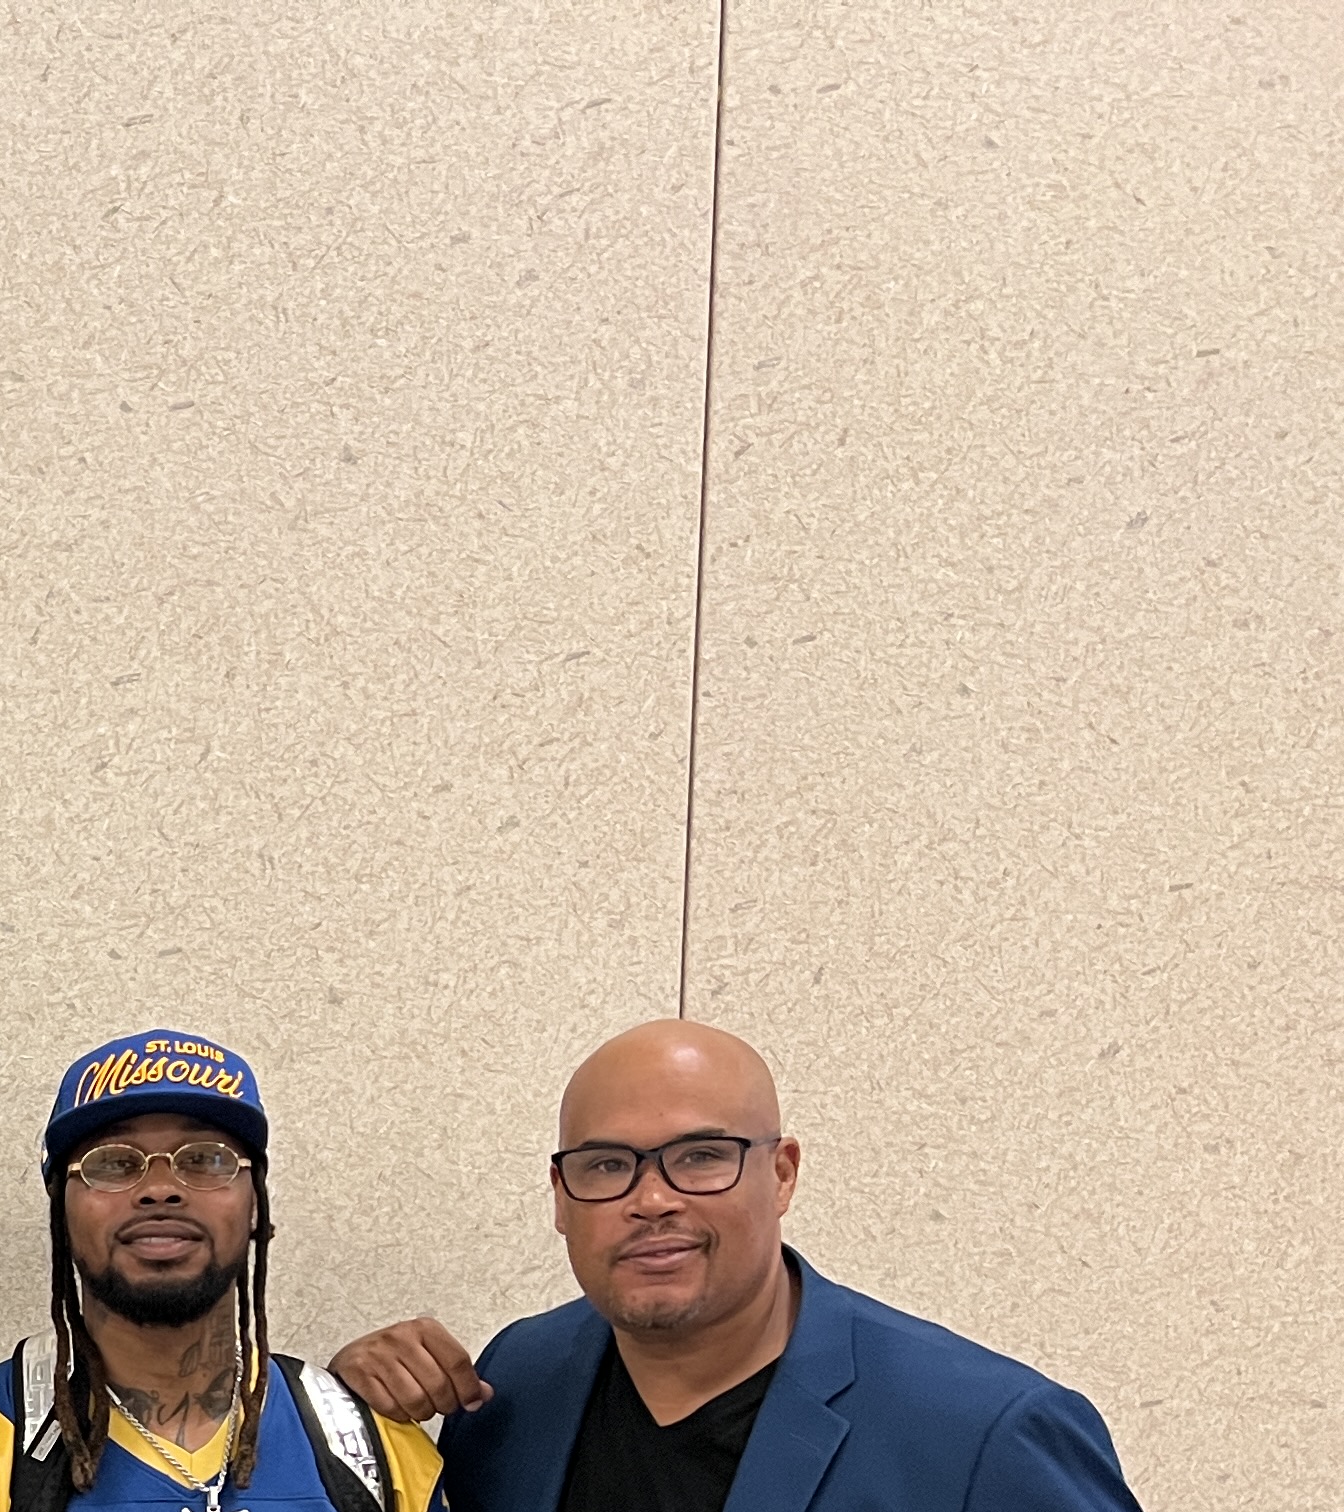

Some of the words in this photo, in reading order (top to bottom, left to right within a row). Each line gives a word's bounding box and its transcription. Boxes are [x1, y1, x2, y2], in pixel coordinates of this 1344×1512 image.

[145, 1040, 171, 1054] ST.
[174, 1040, 225, 1064] LOUIS
[74, 1049, 244, 1108] Missouri
